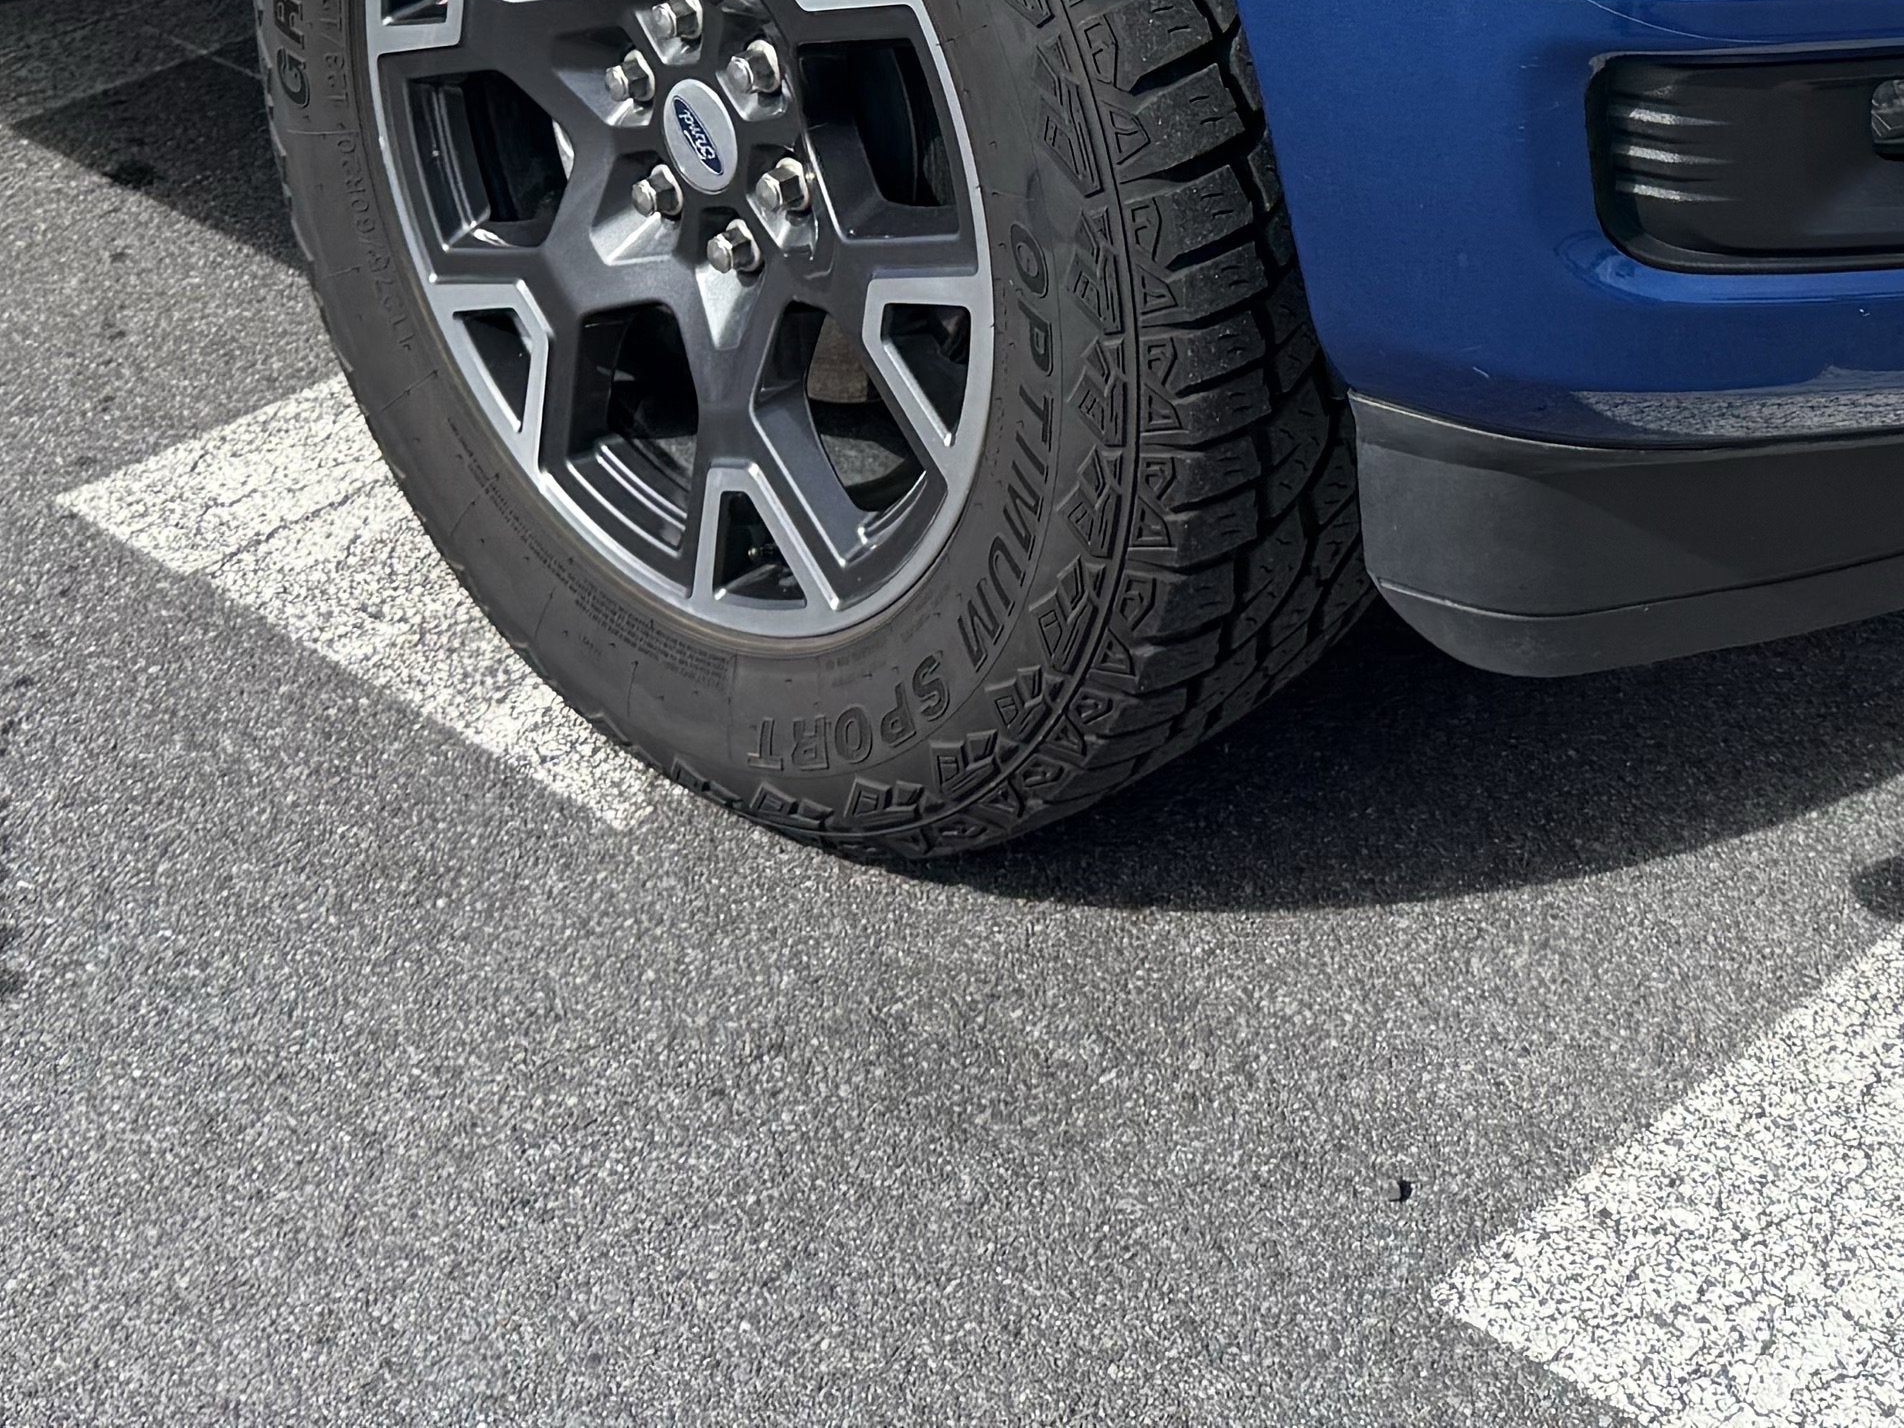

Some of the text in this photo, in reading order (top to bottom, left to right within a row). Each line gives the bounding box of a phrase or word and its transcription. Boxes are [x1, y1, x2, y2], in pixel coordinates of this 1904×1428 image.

[678, 109, 716, 161] Ford
[957, 220, 1055, 674] OPTIMUM
[747, 649, 951, 773] SPORT
